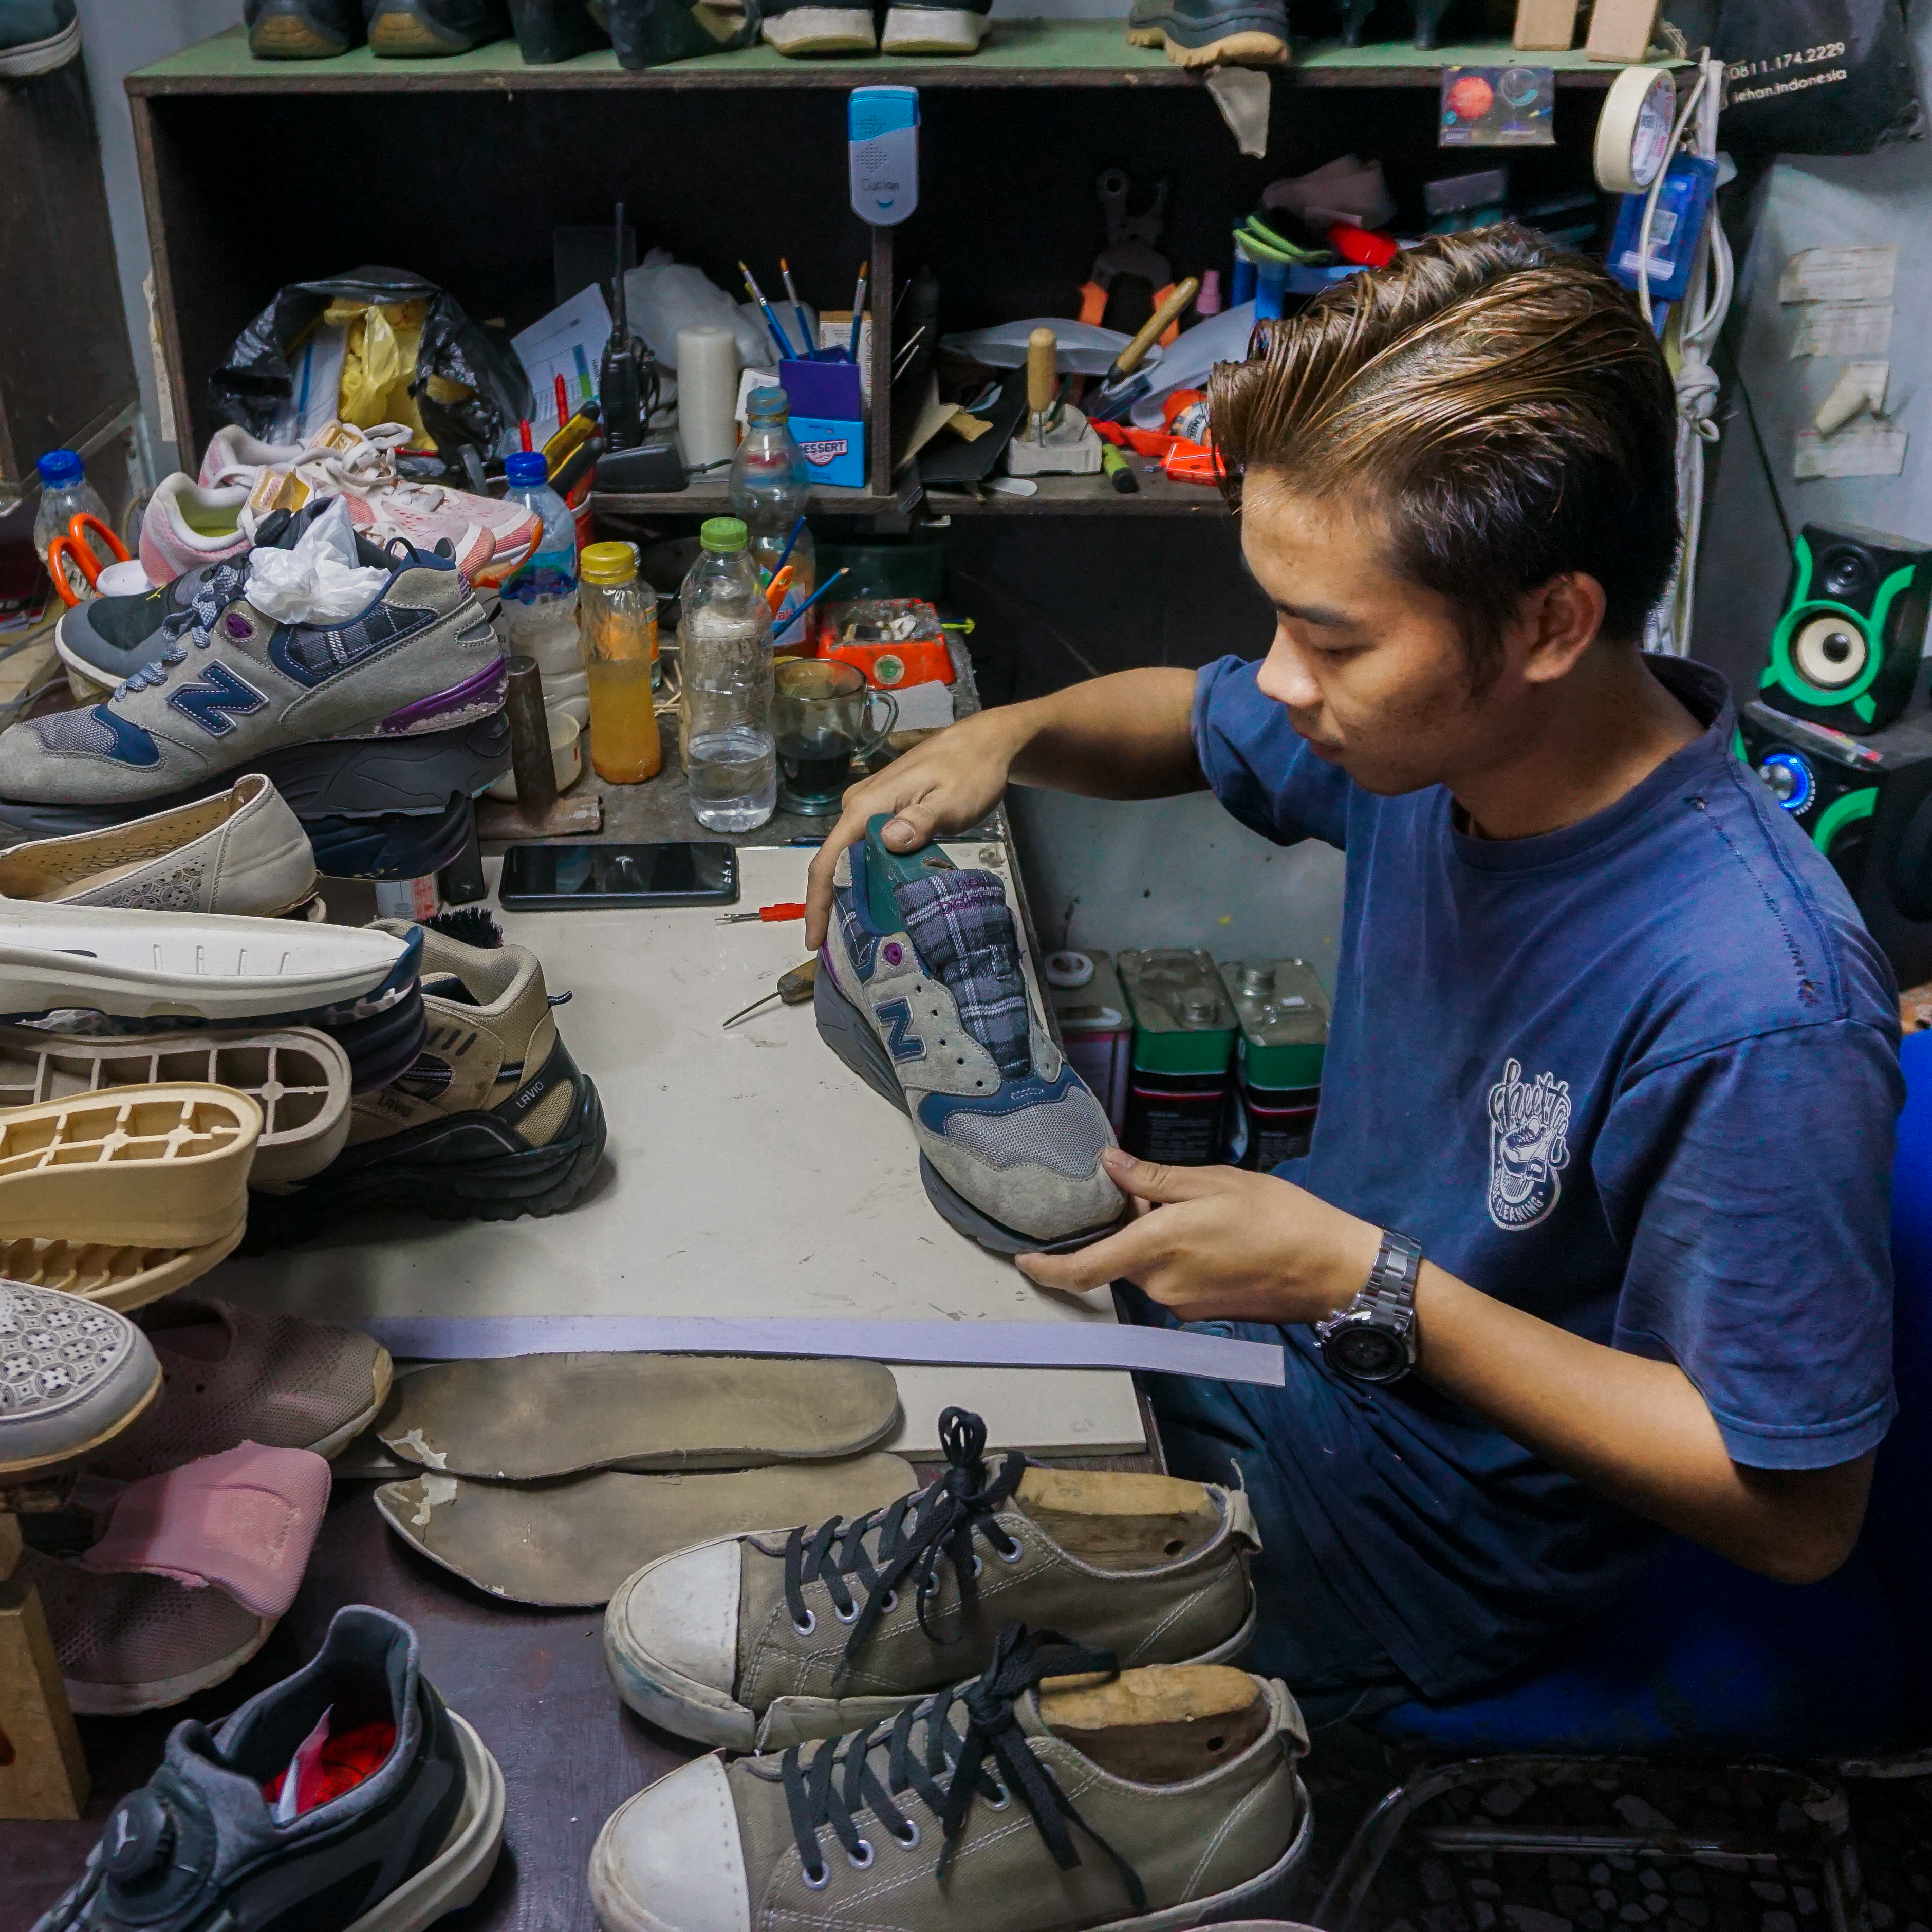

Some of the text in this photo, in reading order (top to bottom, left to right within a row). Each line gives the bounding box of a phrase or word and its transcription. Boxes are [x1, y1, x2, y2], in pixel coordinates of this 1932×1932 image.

[802, 441, 845, 454] ESSERT
[516, 1081, 544, 1108] LAVIO
[1496, 1196, 1544, 1222] CLEANING
